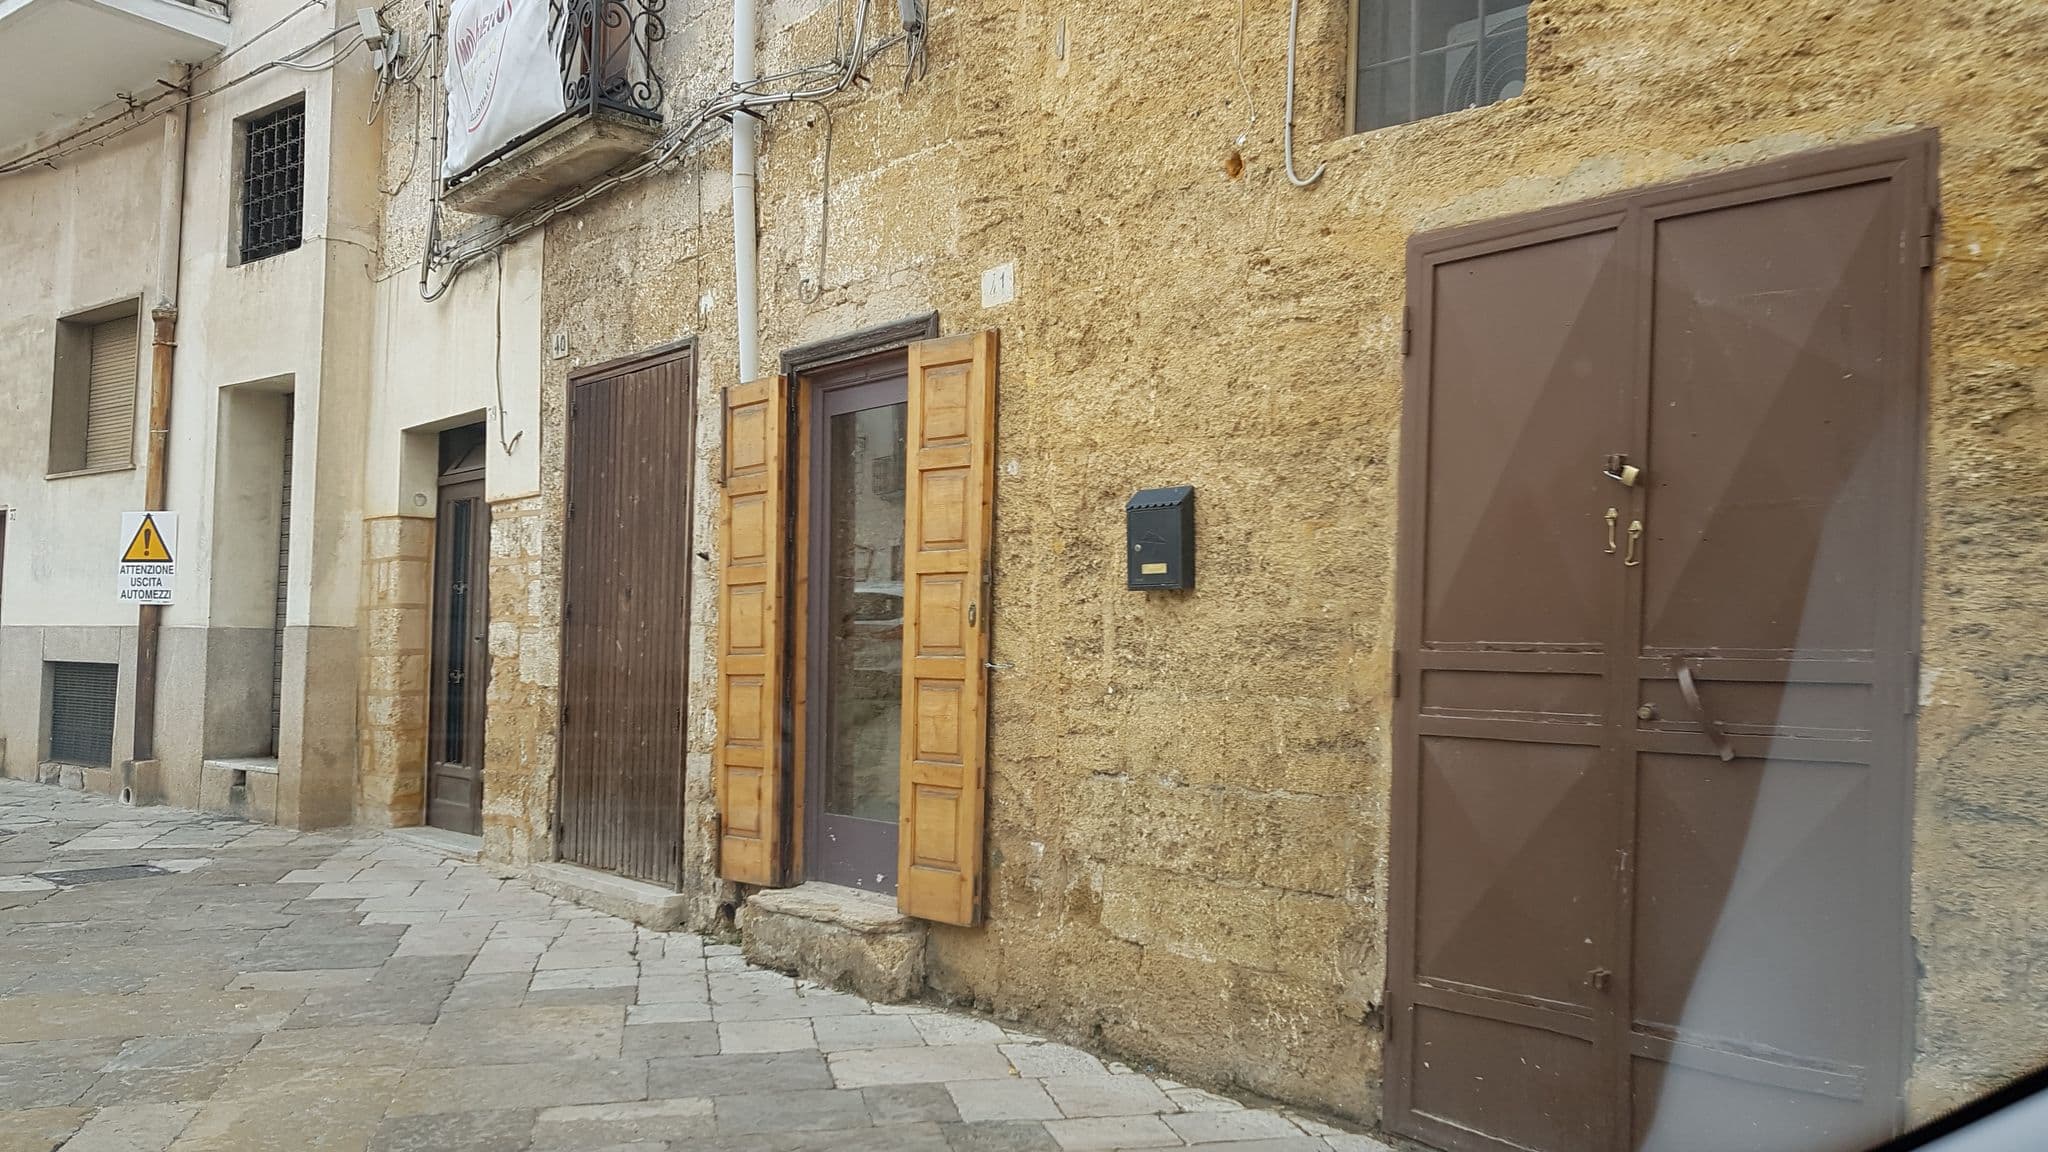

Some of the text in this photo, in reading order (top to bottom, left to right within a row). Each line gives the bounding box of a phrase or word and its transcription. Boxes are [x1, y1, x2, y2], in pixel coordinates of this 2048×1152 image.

[120, 564, 174, 575] ATTENZIONE
[130, 577, 162, 587] USCITA
[120, 589, 172, 600] AUTOMEZZI
